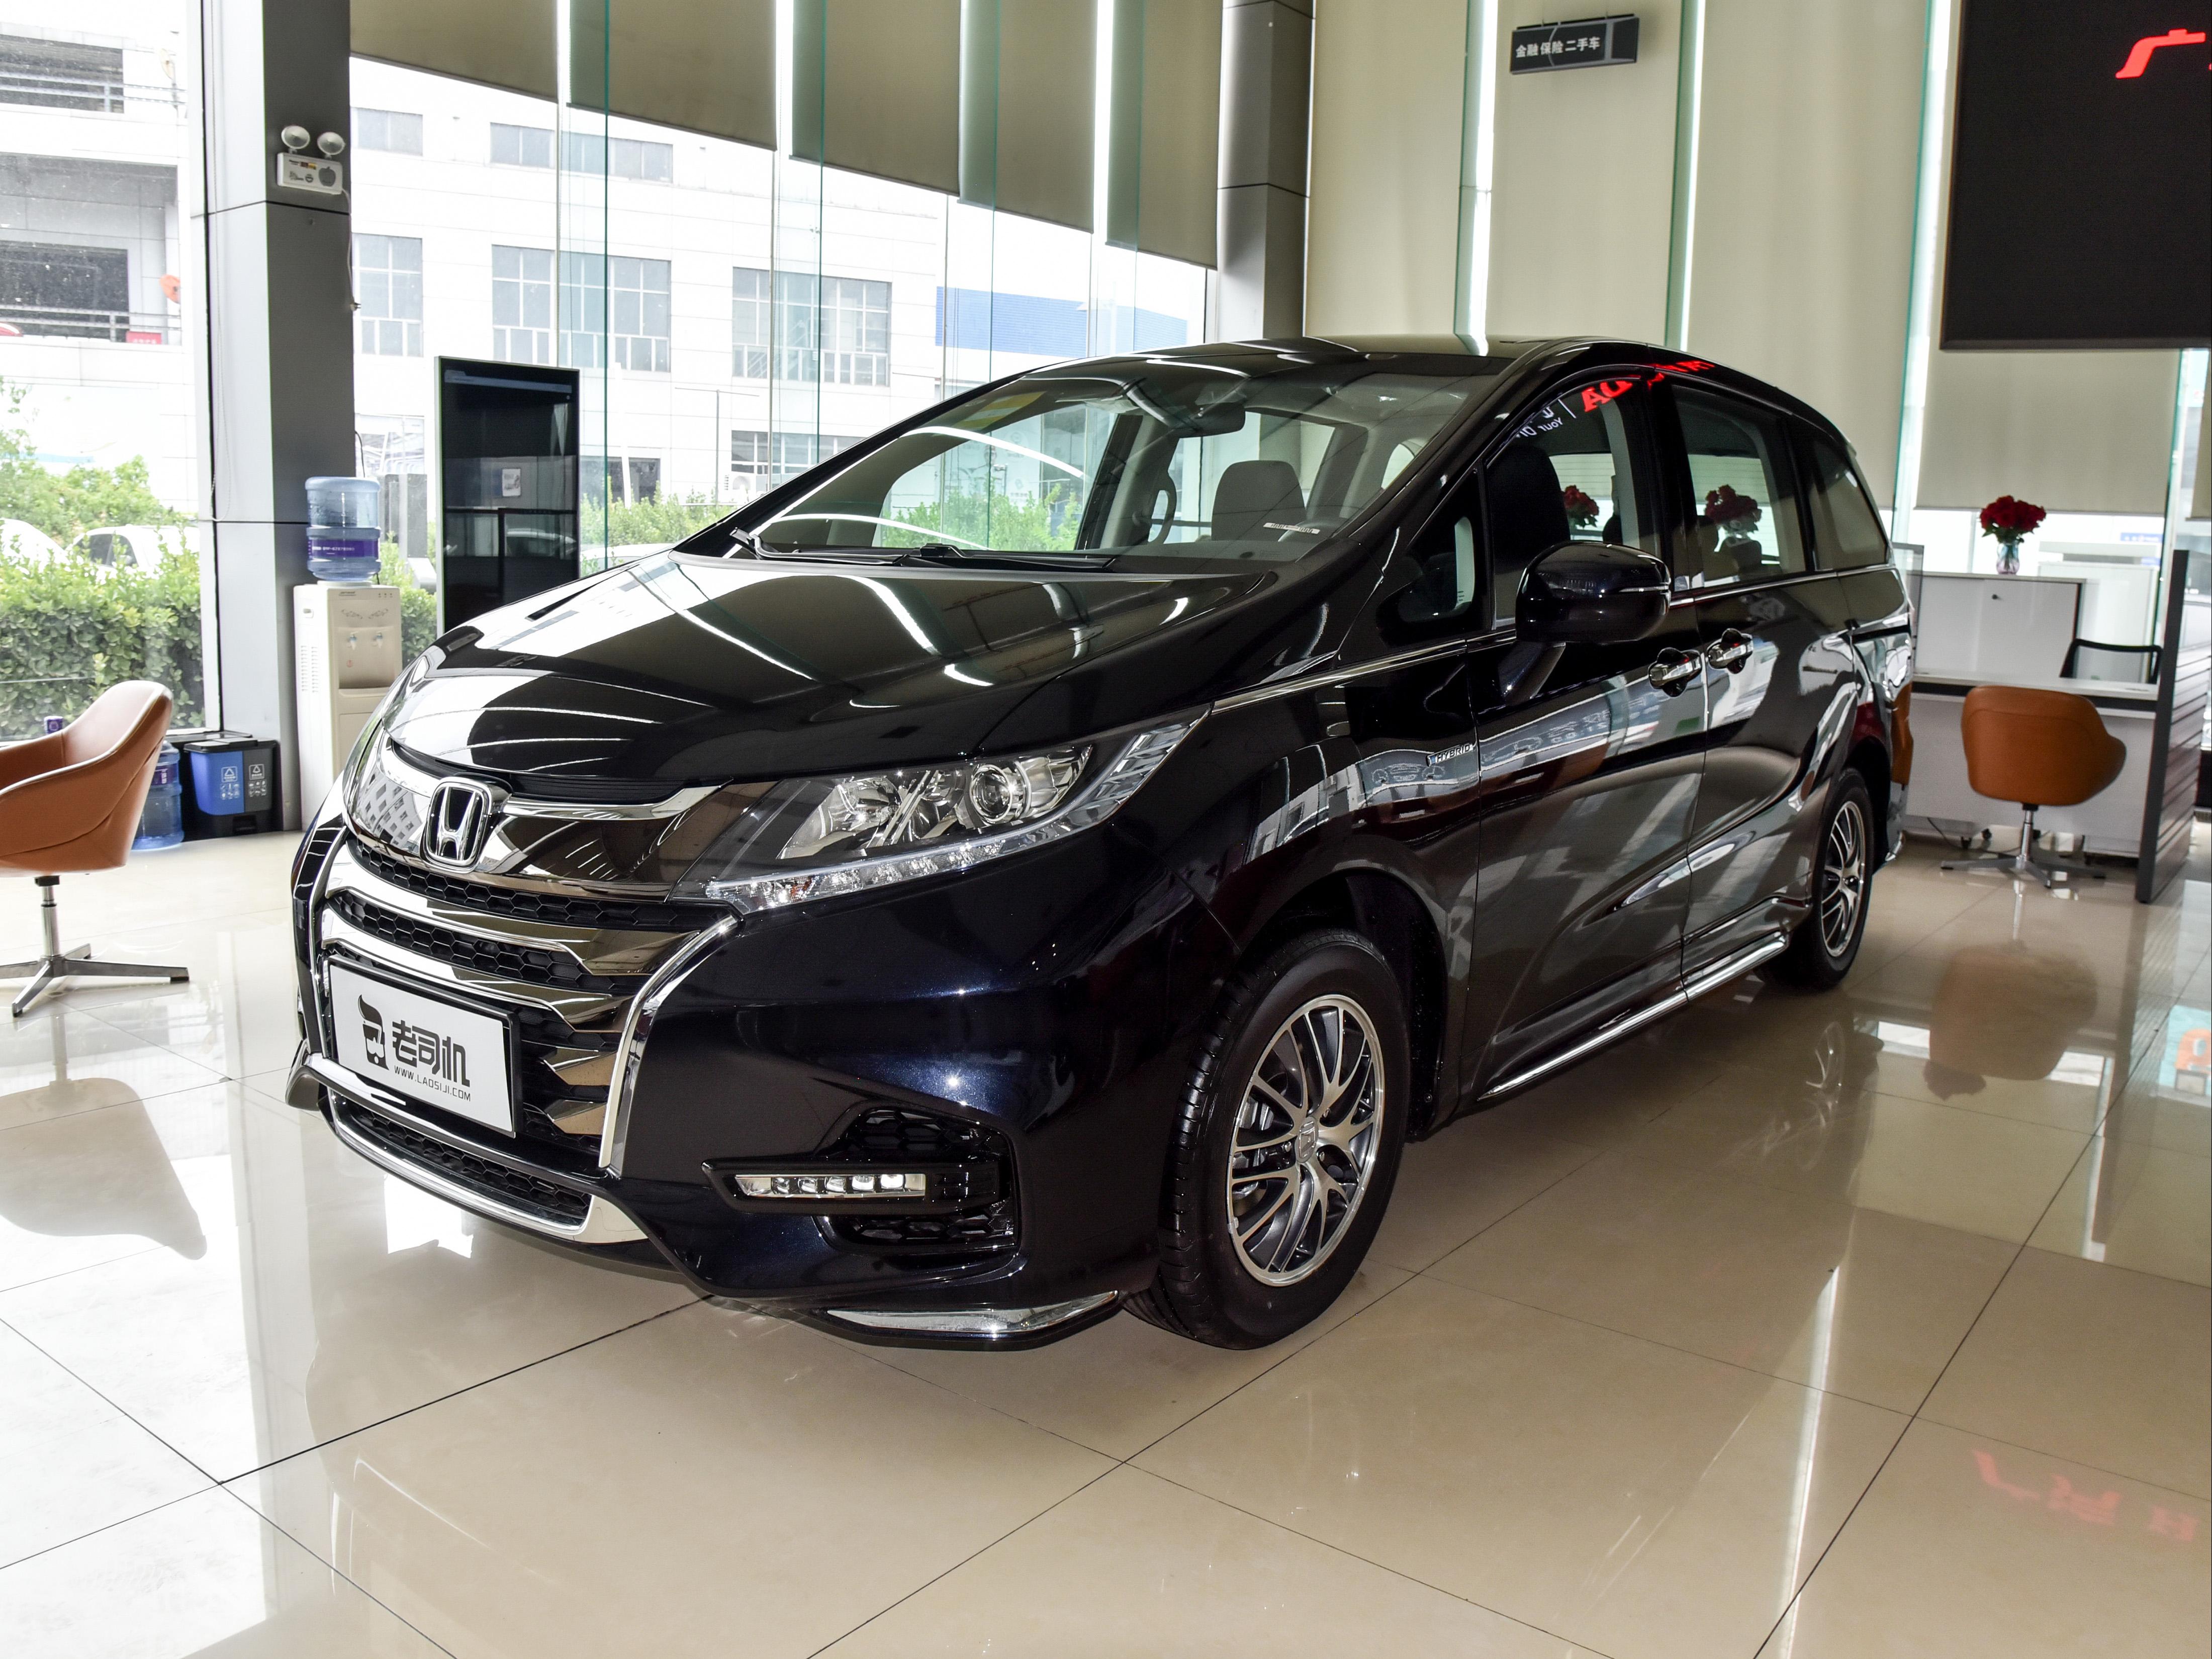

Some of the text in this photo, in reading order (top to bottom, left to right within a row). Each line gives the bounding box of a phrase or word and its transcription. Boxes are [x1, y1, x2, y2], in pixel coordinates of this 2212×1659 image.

[1515, 36, 1601, 58] 金融 保险 二手车
[2115, 28, 2211, 79] 广
[1437, 744, 1470, 763] HYBRID
[392, 1020, 471, 1087] 老司机
[394, 1065, 471, 1102] WWW.LAOSIJI.COM
